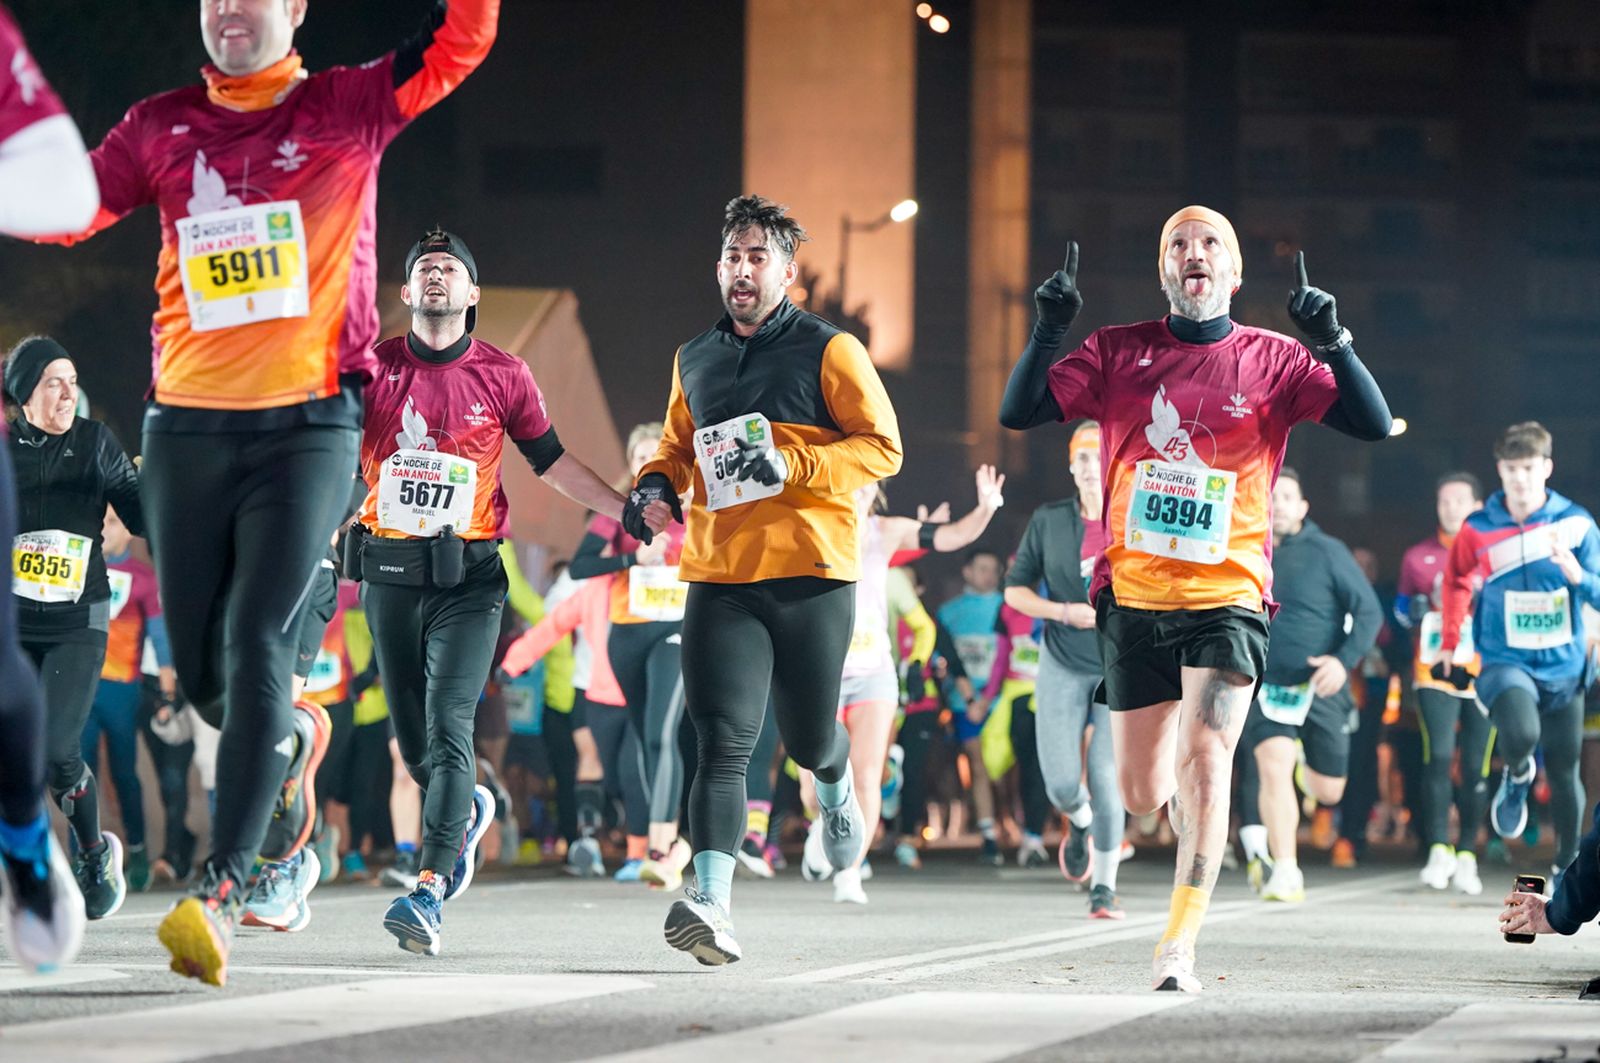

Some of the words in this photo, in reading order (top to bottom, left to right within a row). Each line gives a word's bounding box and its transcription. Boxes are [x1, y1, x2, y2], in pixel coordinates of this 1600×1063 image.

[208, 246, 280, 287] 5911
[1164, 436, 1189, 461] 43
[391, 468, 410, 479] SAN
[403, 459, 430, 471] NOCHE
[431, 462, 442, 471] DE
[1143, 480, 1162, 493] SAN
[1162, 484, 1197, 497] ANTÓN
[1156, 471, 1184, 484] NOCHE
[1185, 476, 1198, 486] DE
[399, 480, 455, 510] 5677
[1145, 494, 1214, 531] 9394
[20, 552, 72, 579] 6355
